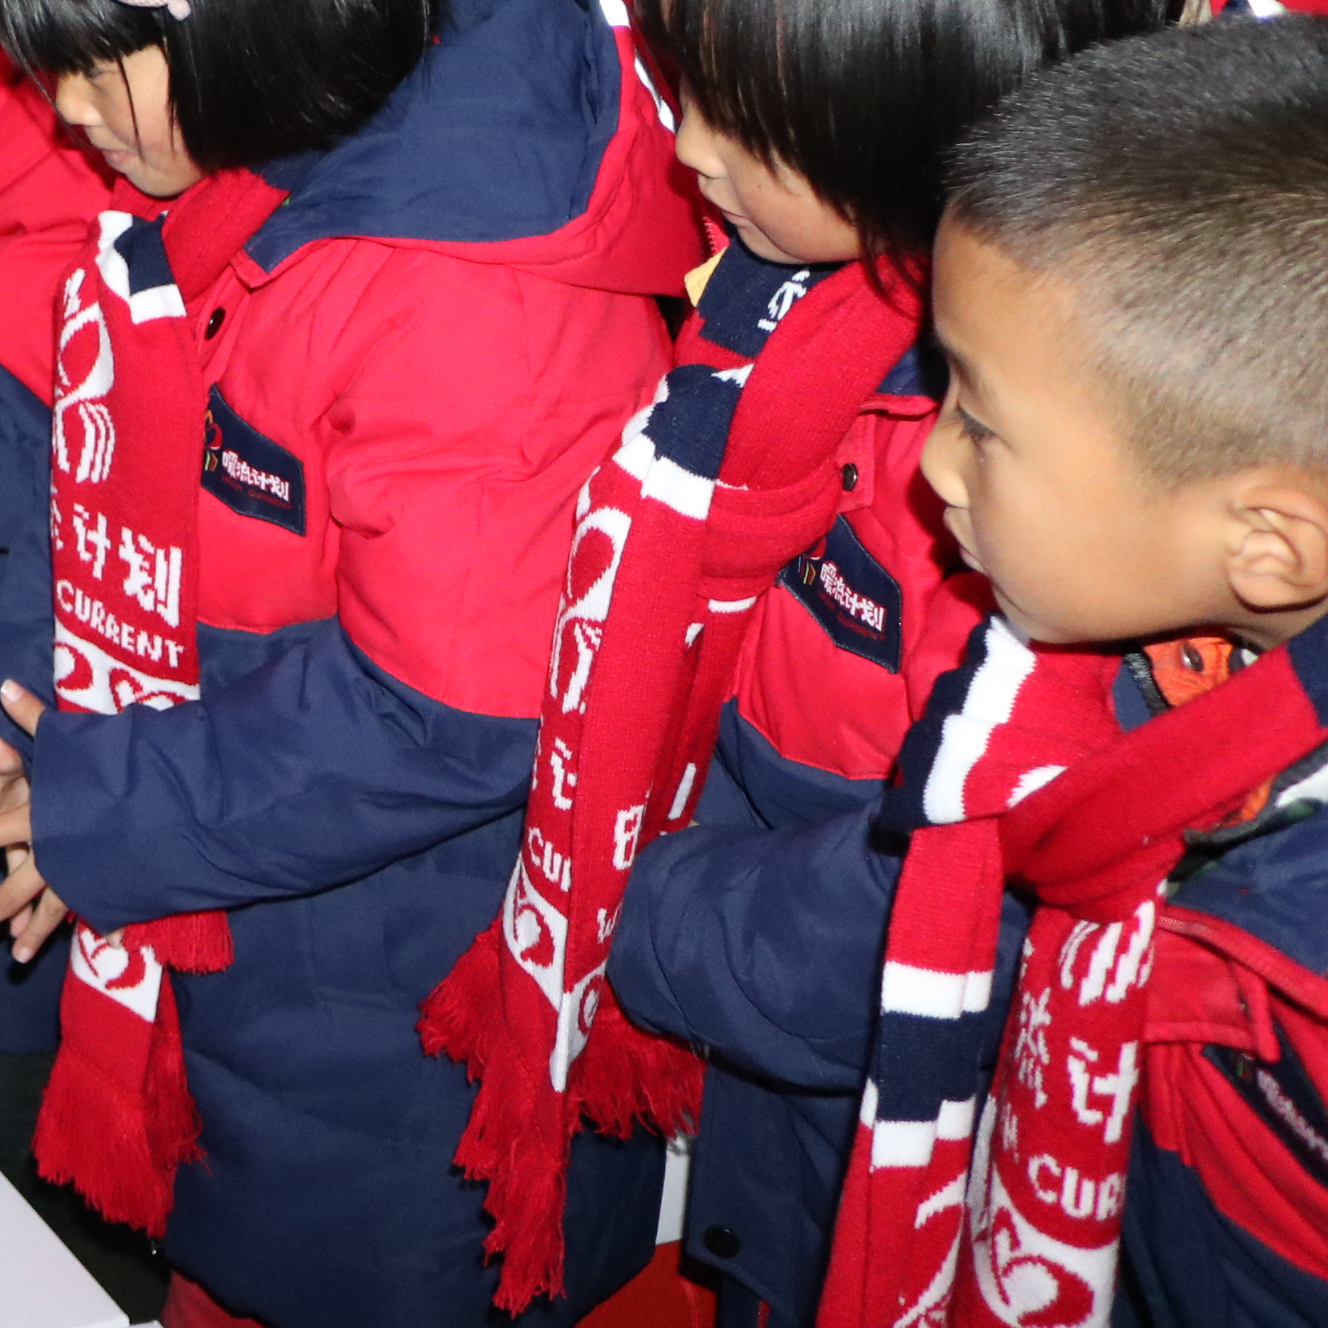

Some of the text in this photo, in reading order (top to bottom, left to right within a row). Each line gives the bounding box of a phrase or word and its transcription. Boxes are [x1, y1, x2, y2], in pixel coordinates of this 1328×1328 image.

[222, 450, 290, 502] 暖流计划
[56, 579, 185, 669] CURRENT
[819, 562, 885, 632] 暖流计划
